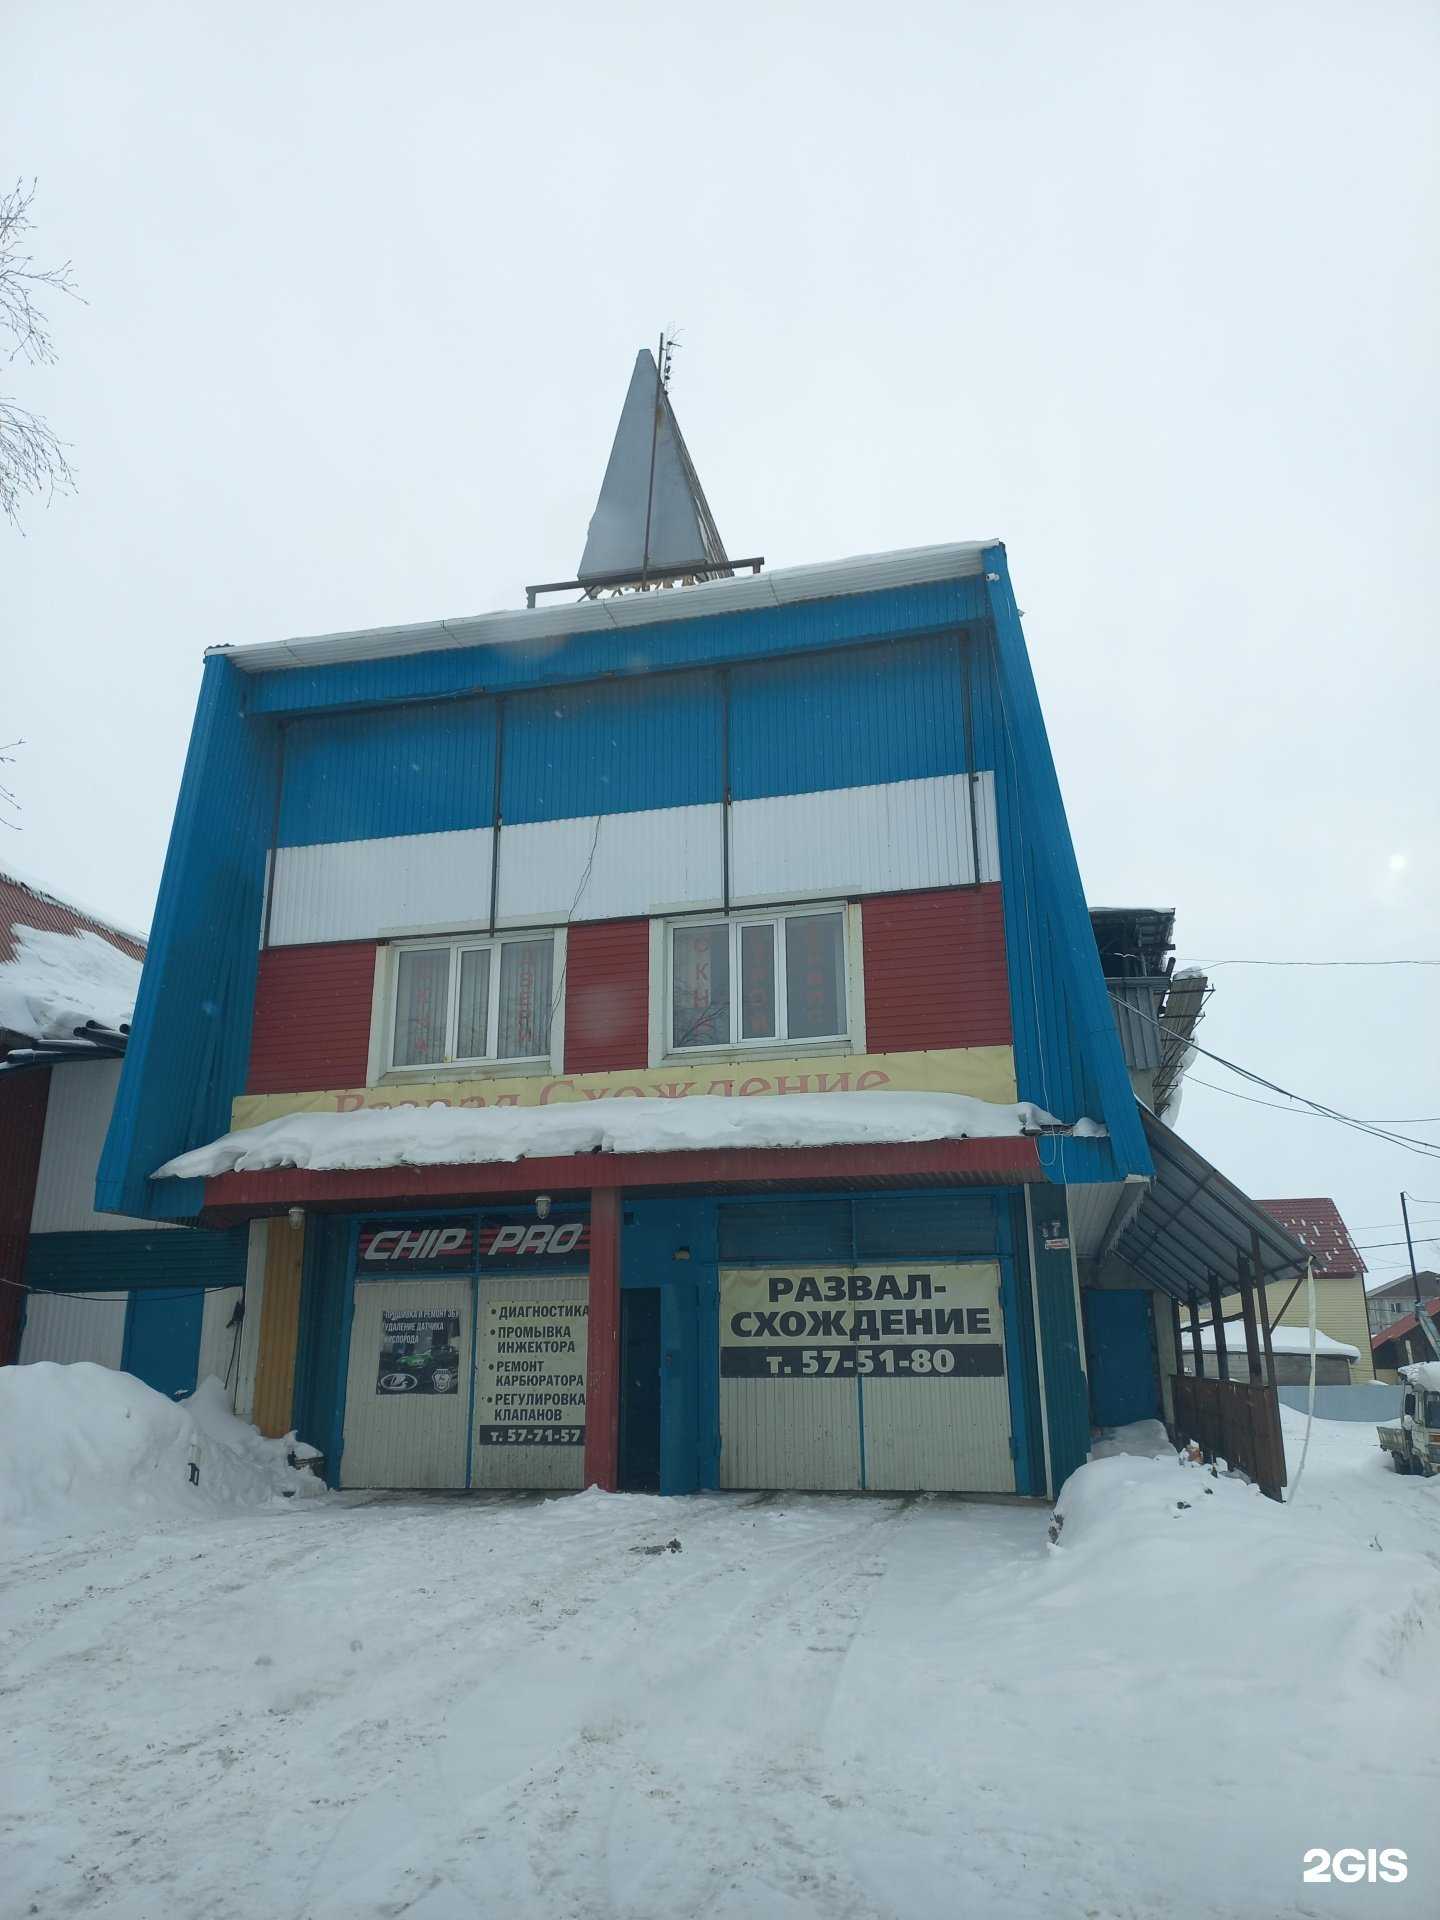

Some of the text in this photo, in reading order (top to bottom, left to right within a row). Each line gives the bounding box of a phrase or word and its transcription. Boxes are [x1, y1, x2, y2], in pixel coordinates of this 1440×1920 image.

[364, 1223, 583, 1260] CHIP PRO
[768, 1274, 947, 1303] РАЗВАЛ-
[499, 1305, 589, 1320] ДИАГНОСТИКА
[730, 1307, 992, 1342] СХОЖДЕНИЕ
[498, 1326, 571, 1338] ПРОМЫВКА
[497, 1341, 575, 1353] ИНЖЕКТОРА
[496, 1361, 544, 1372] РЕМОНТ
[766, 1350, 956, 1374] т. 57-51-80
[496, 1375, 583, 1386] КАРБЮРАТОРА
[495, 1393, 586, 1405] РЕГУЛИРОВКА
[494, 1409, 562, 1421] КЛАПАНОВ
[490, 1429, 581, 1442] т. 57-71-57
